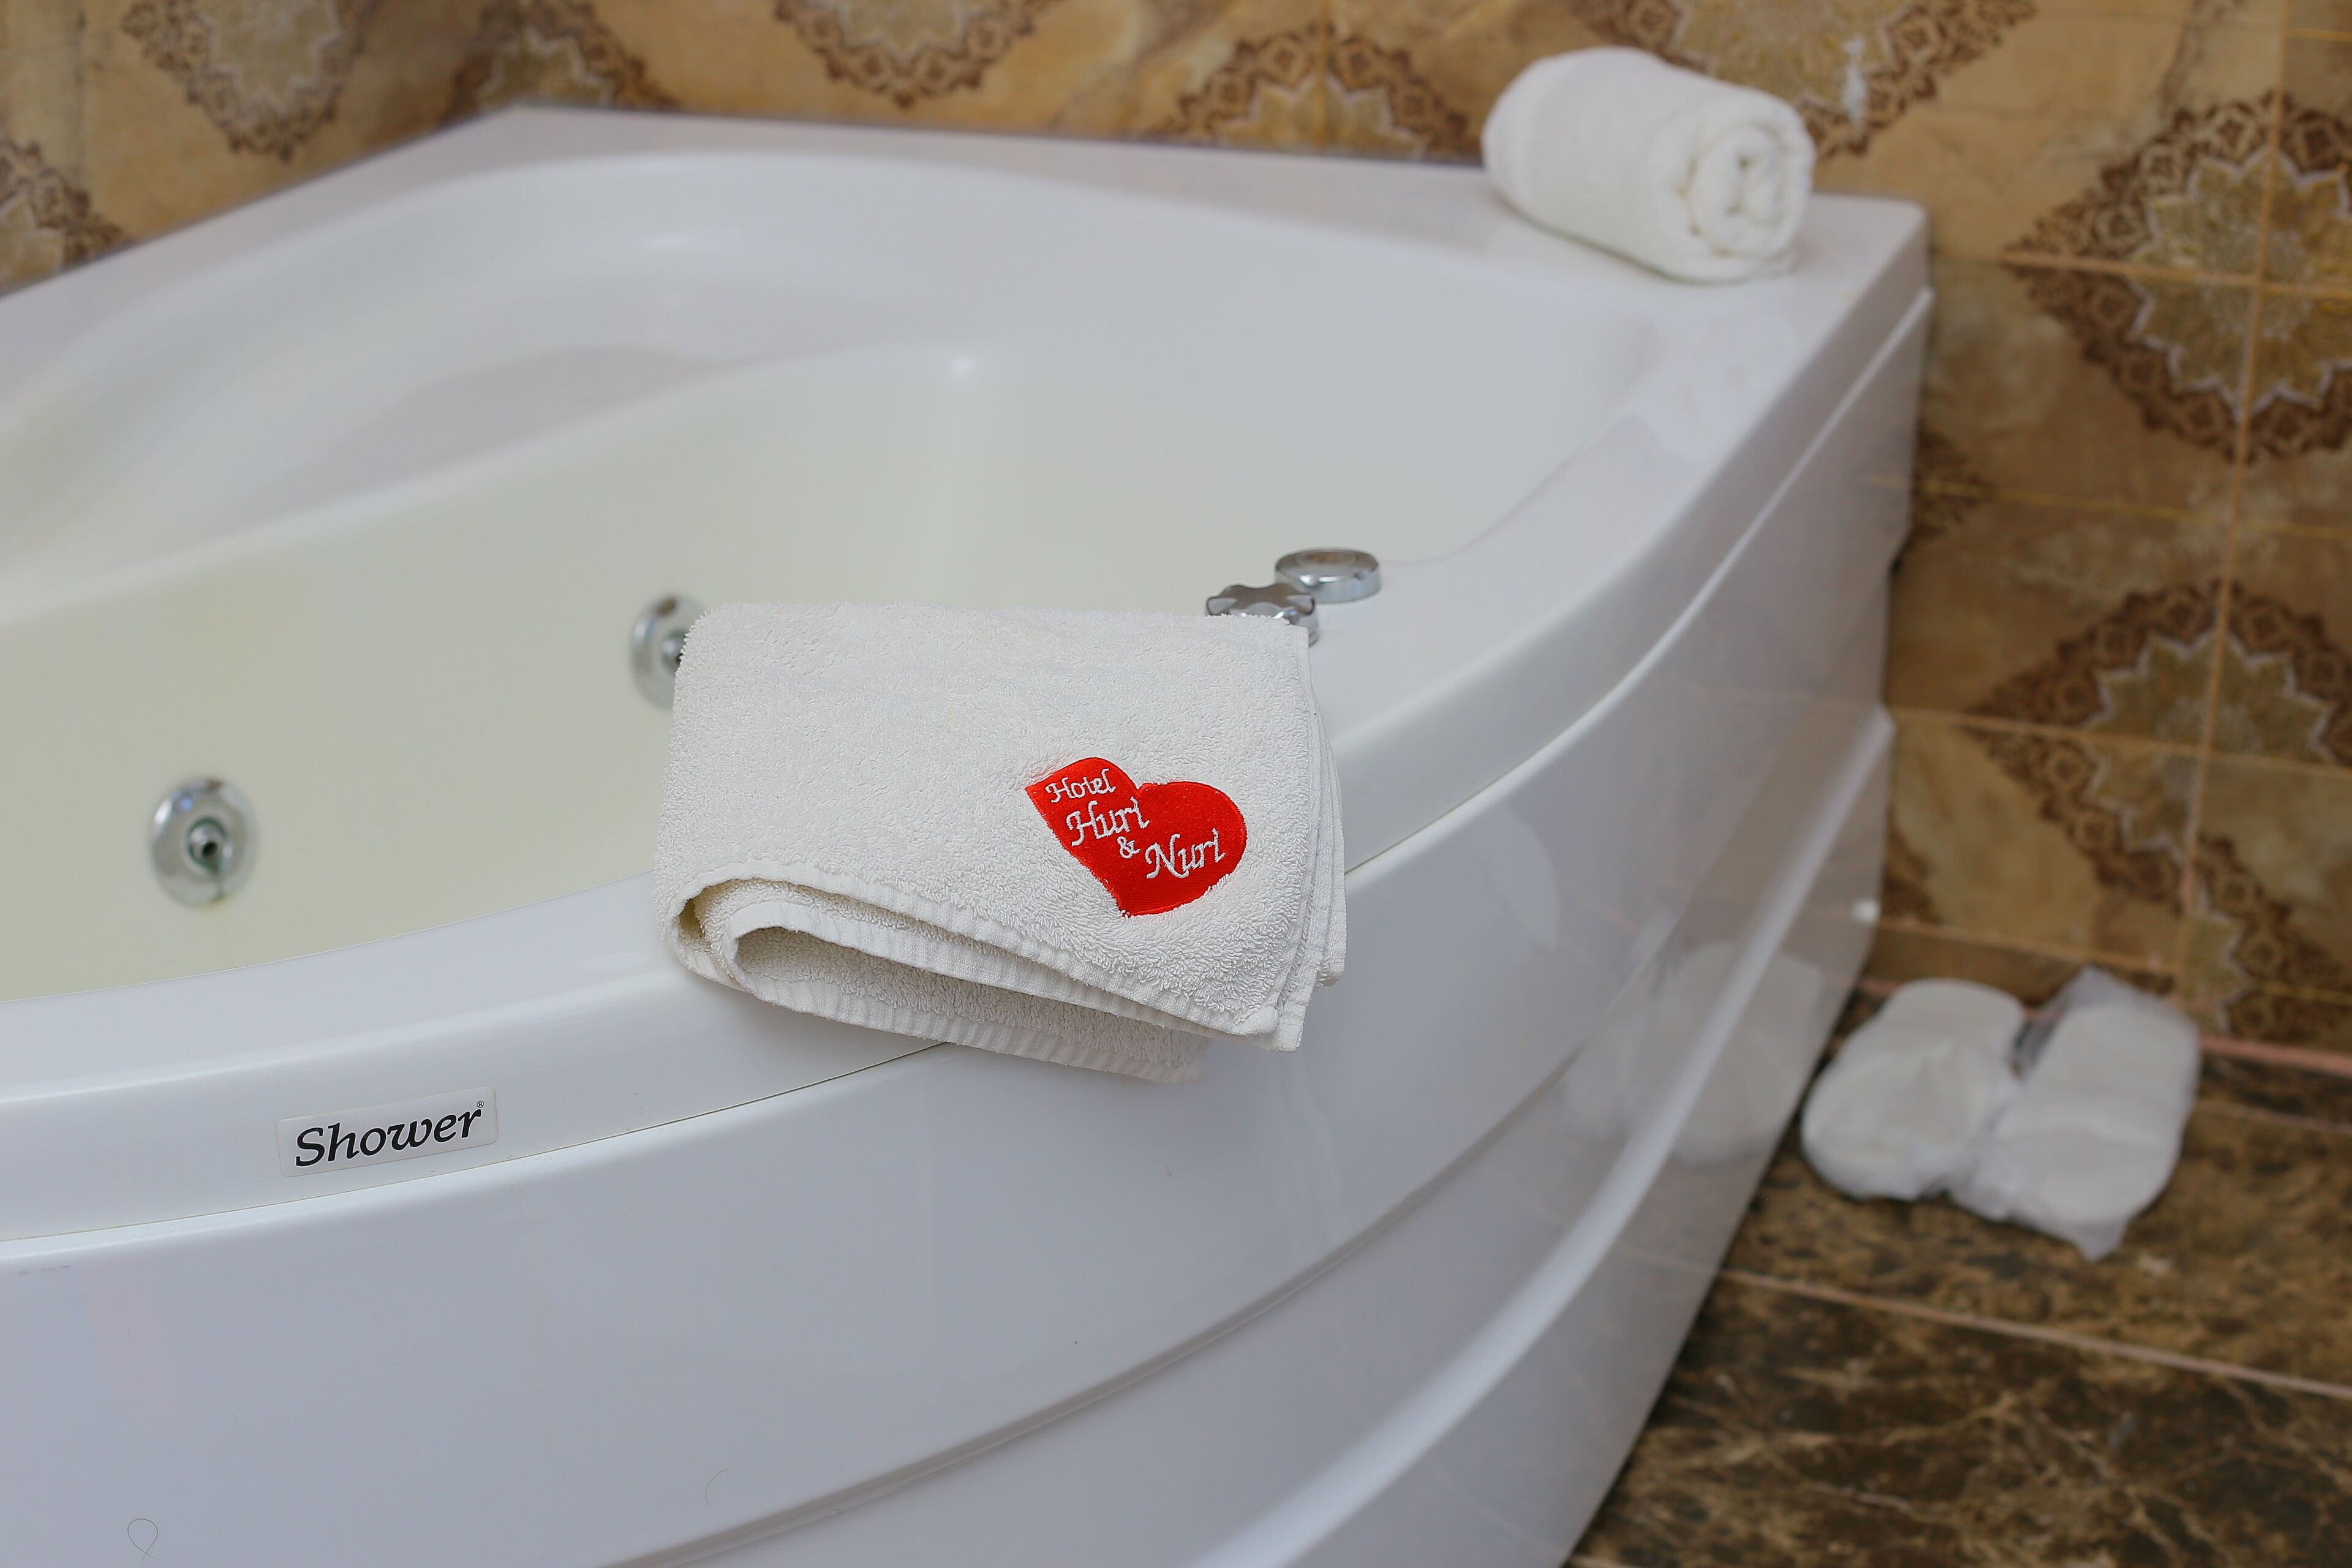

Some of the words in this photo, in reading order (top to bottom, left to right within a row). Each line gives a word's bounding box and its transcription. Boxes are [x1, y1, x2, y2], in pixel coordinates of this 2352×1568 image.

[1046, 768, 1116, 802] Hotel
[1066, 797, 1150, 846] Huri
[1117, 836, 1141, 859] &
[1145, 828, 1226, 879] Nuri
